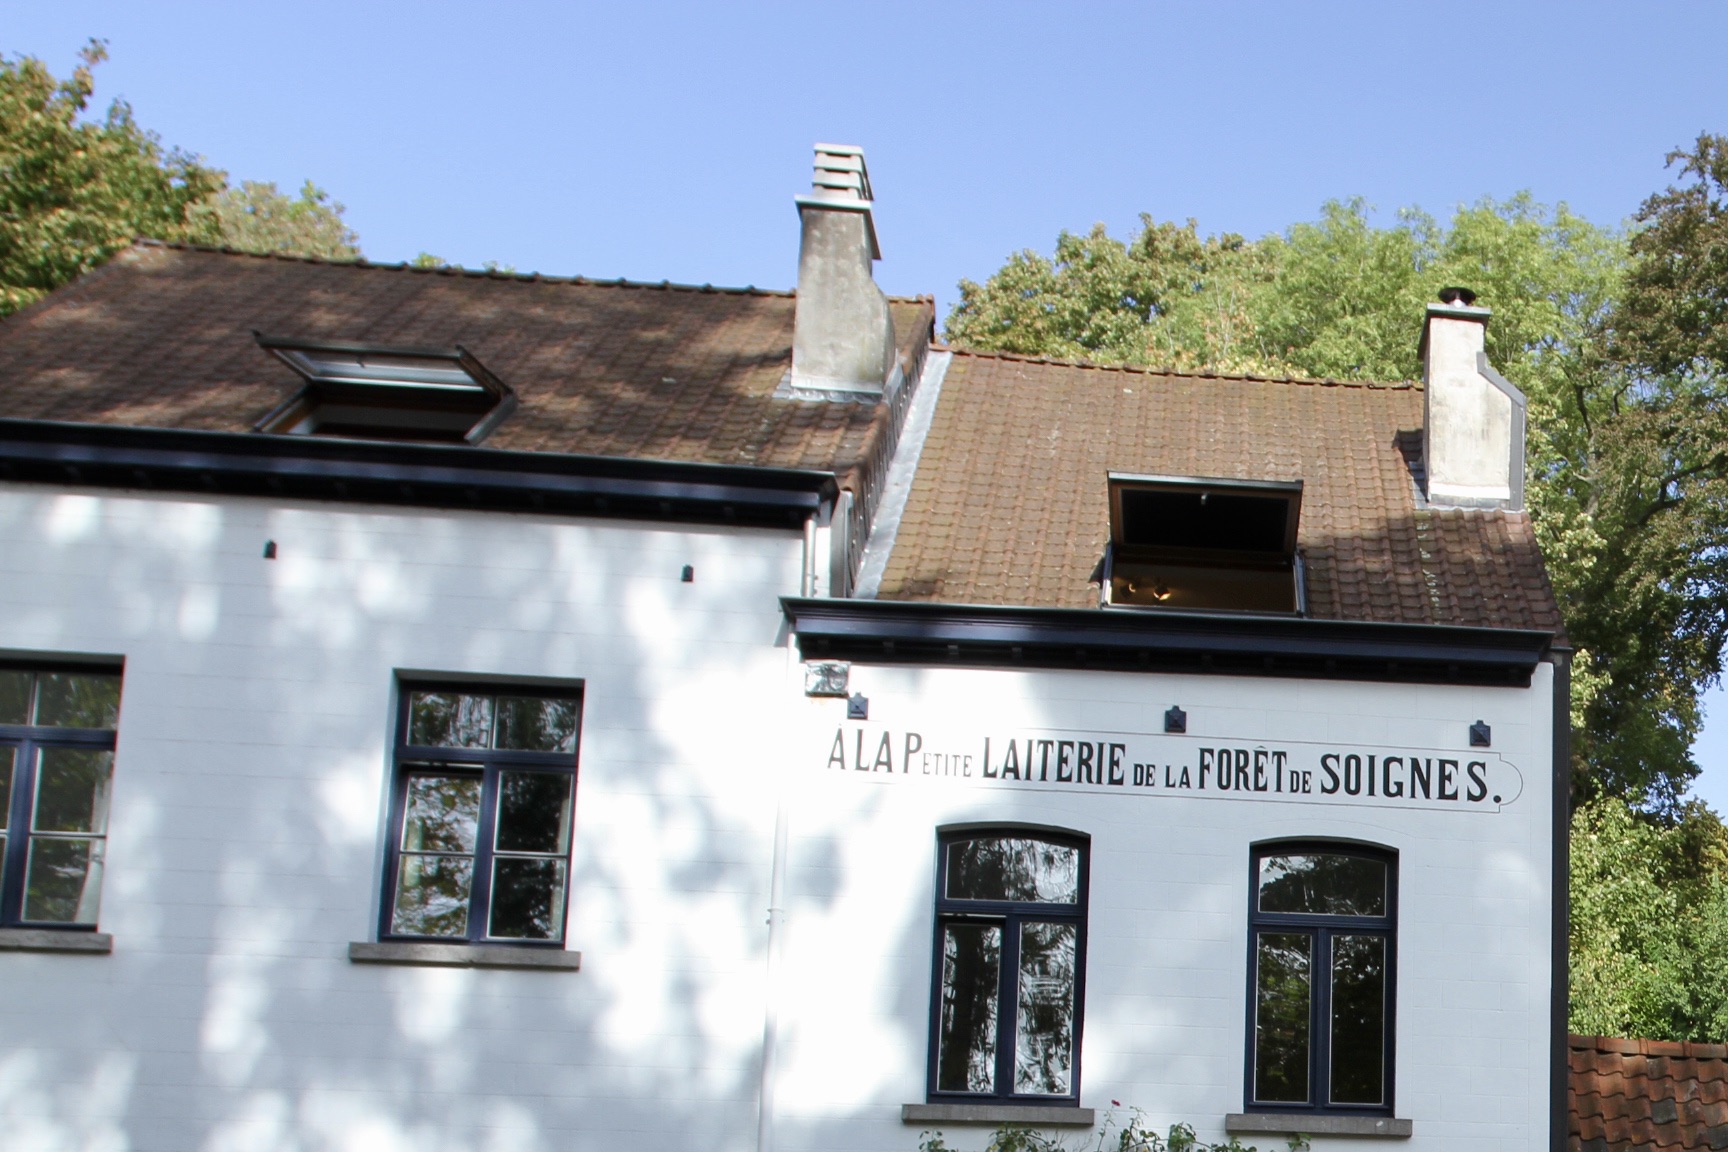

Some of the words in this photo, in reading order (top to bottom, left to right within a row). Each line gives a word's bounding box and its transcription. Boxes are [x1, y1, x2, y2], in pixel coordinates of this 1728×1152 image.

[854, 728, 894, 773] LA
[981, 736, 1127, 787] LAITERIE
[1132, 763, 1156, 787] DE
[1164, 764, 1192, 789] LA
[1198, 745, 1288, 793] FORÊT
[1289, 770, 1312, 794] DE
[1320, 753, 1502, 803] SOIGNES.
